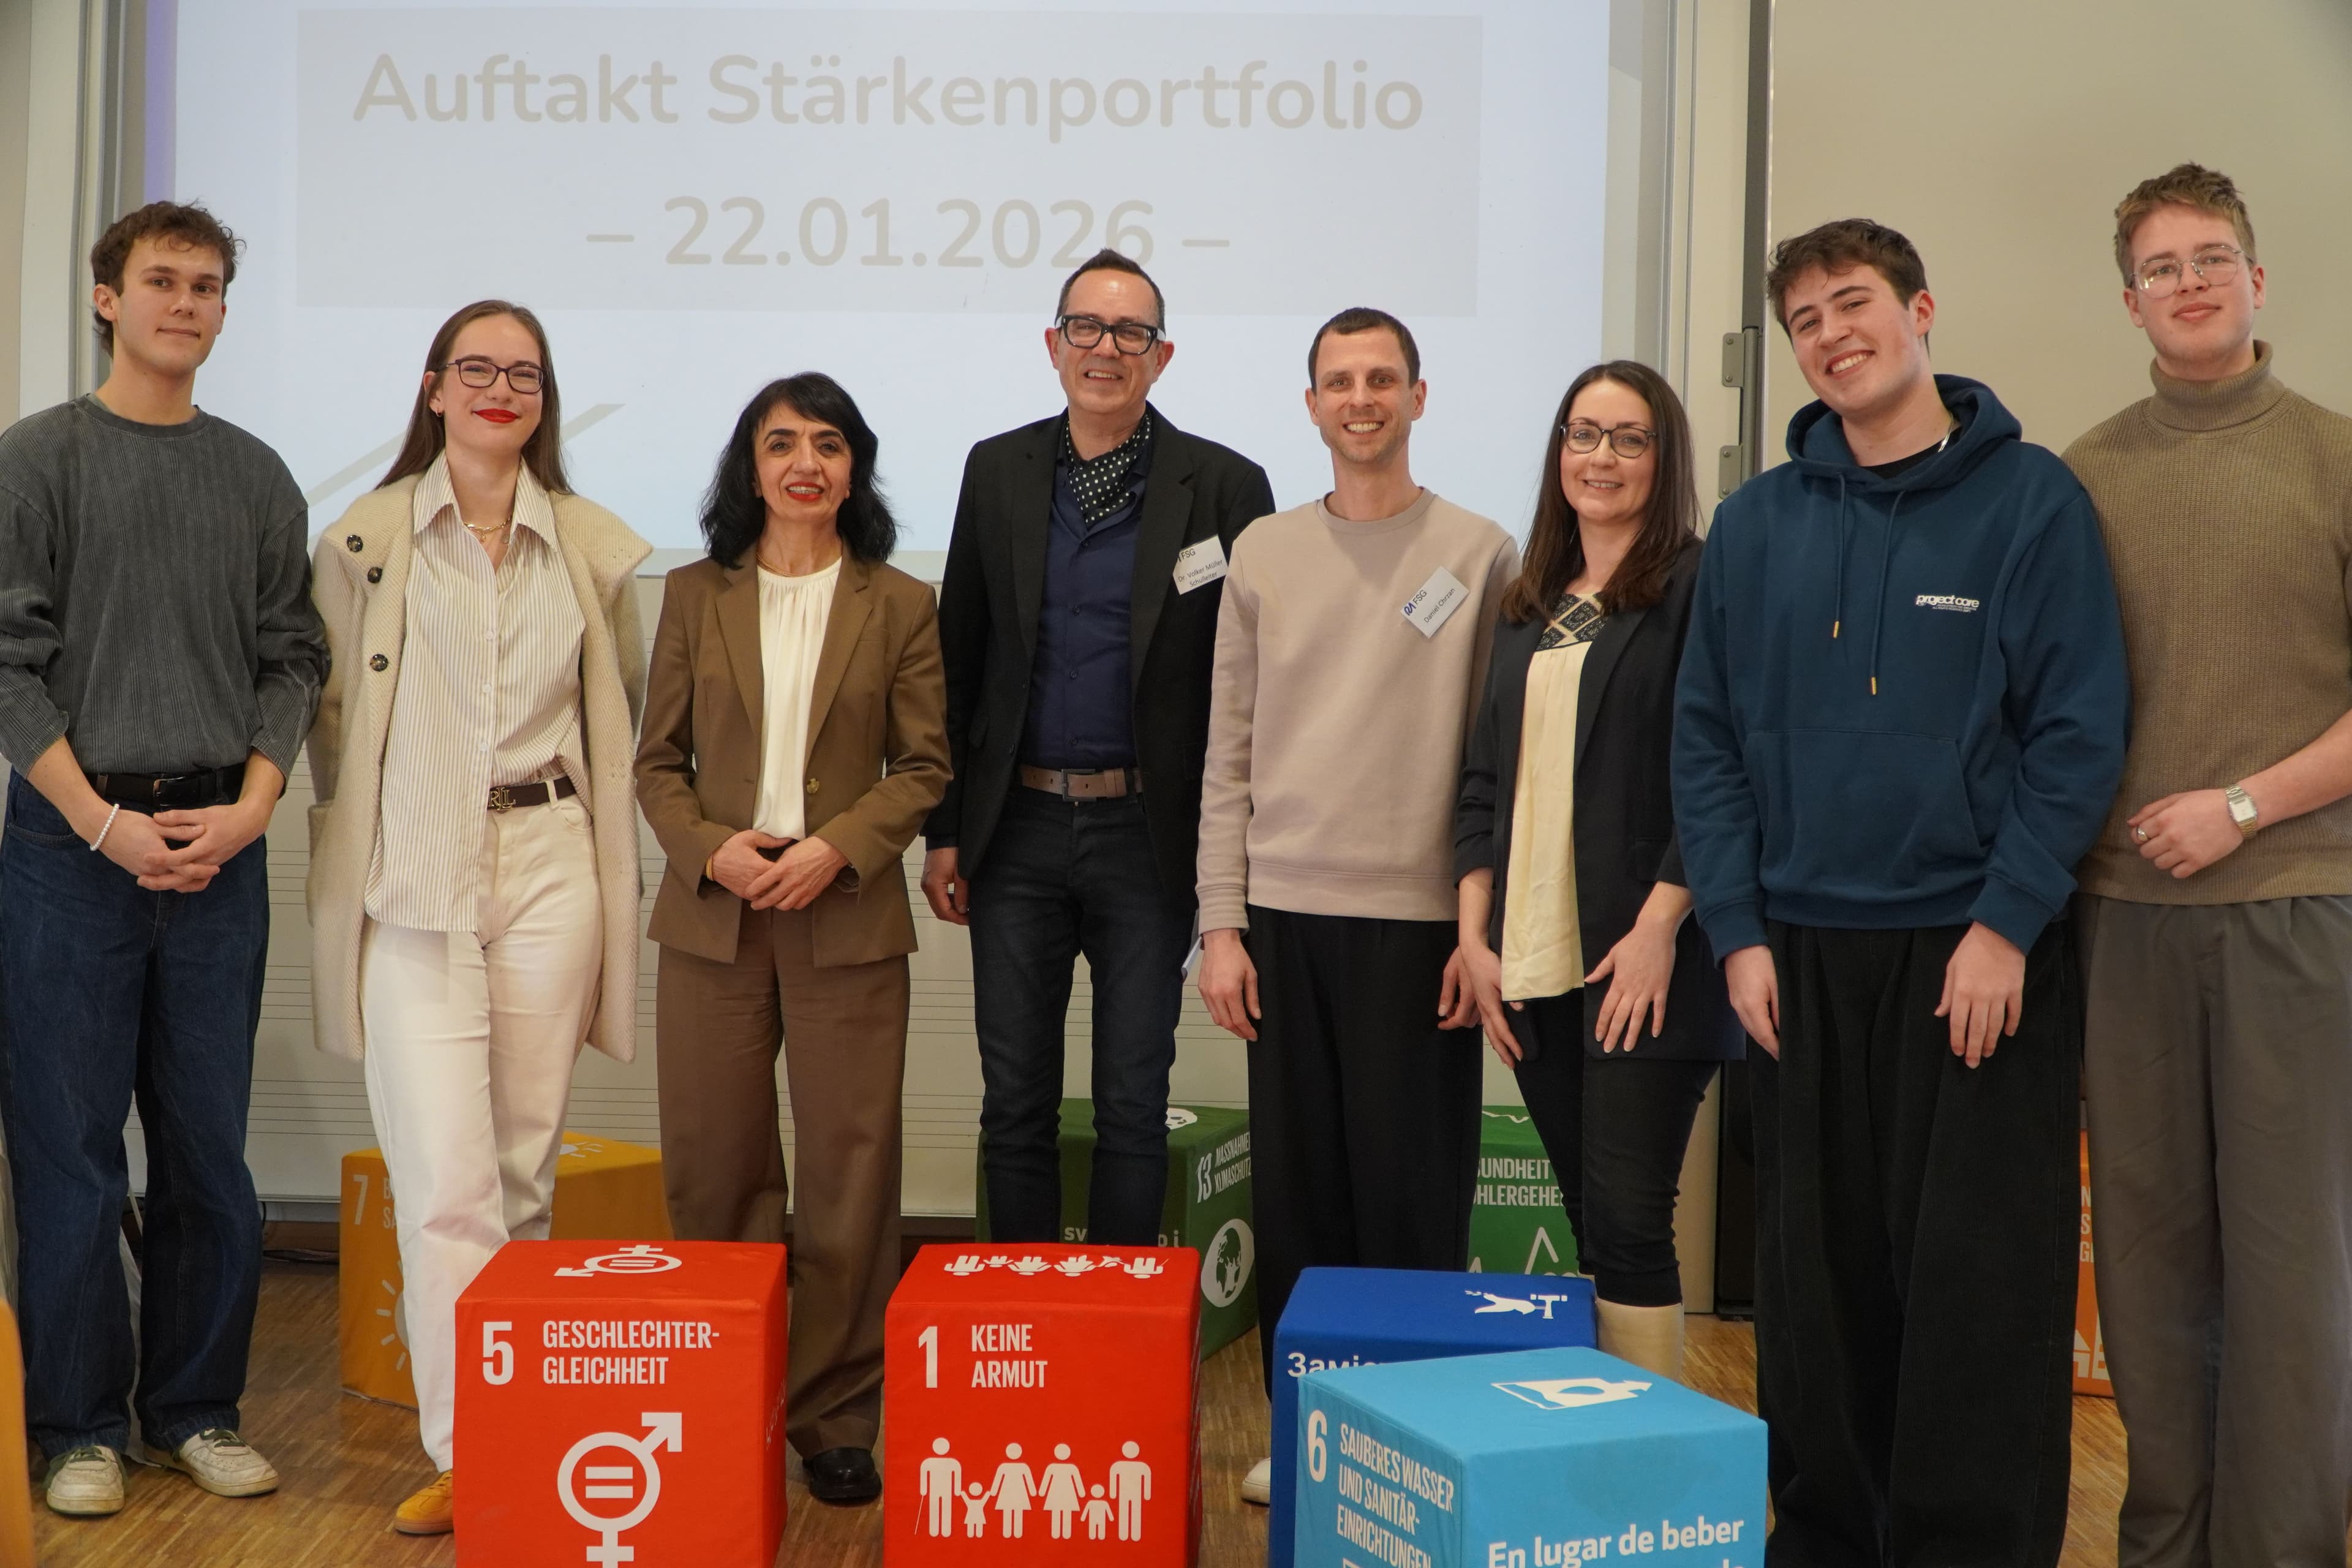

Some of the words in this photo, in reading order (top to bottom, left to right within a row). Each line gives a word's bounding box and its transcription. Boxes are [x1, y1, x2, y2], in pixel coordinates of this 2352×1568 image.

[353, 53, 679, 123] Auftakt
[707, 55, 1423, 143] Stärkenportfolio
[663, 196, 1155, 268] 22.01.2026
[1181, 548, 1196, 560] FSG
[1187, 568, 1204, 578] Volker
[1205, 559, 1223, 570] Müller
[1189, 571, 1218, 587] Schulleiter
[1412, 590, 1427, 605] FSG
[1423, 605, 1440, 622] Daniel
[1438, 588, 1455, 606] Chrzan
[1955, 598, 1980, 608] core
[1196, 1153, 1212, 1204] 13
[1214, 1156, 1251, 1194] KLIMASCHUTZ
[1478, 1158, 1550, 1180] UNDHEIT
[353, 1174, 369, 1225] 7
[1473, 1185, 1563, 1207] HLERGEHE
[483, 1321, 514, 1385] 5
[543, 1320, 720, 1349] GESCHLECHTER-
[543, 1357, 669, 1384] GLEICHHEIT
[919, 1326, 938, 1389] 1
[971, 1324, 1033, 1352] KEINE
[971, 1360, 1048, 1388] ARMUT
[1308, 1410, 1327, 1482] 6
[1340, 1423, 1400, 1483] SAUBERES
[1401, 1455, 1454, 1515] WASSER
[1338, 1463, 1362, 1504] UND
[1365, 1478, 1420, 1536] SANITÄR-
[1337, 1504, 1432, 1568] EINRICHTUNGEN
[1488, 1542, 1526, 1568] En
[1534, 1536, 1612, 1568] lugar
[1619, 1524, 1654, 1556] de
[1662, 1516, 1744, 1551] beber
